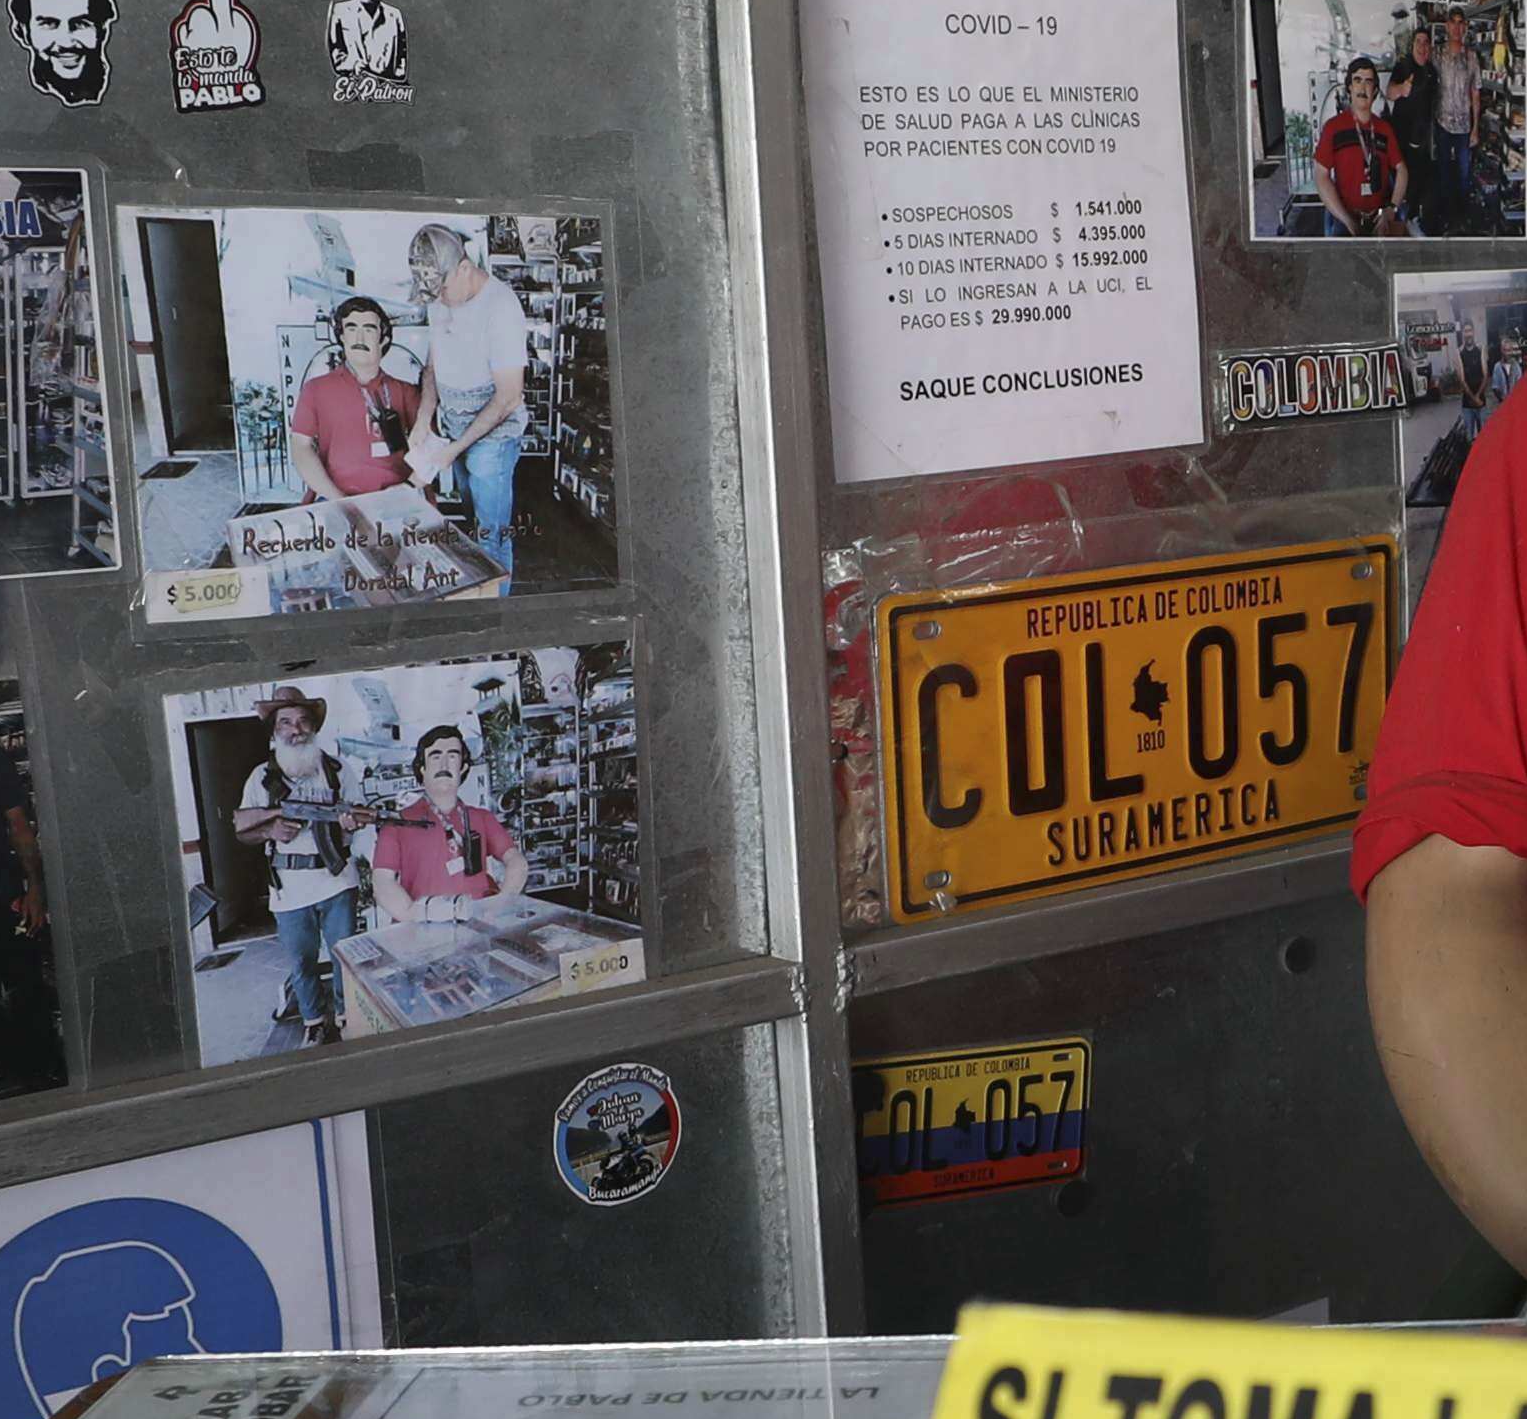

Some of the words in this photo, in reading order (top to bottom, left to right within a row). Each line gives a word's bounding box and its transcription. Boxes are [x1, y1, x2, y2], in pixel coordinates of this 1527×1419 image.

[945, 13, 1011, 35] COVID
[1036, 16, 1057, 36] 19
[179, 83, 262, 110] PABLO
[860, 86, 907, 103] ESTO
[917, 86, 939, 103] ES
[948, 87, 970, 103] LO
[979, 86, 1015, 103] QUE
[1023, 87, 1042, 103] EL
[1050, 86, 1138, 102] MINISTERIO
[892, 204, 1013, 223] SOSPECHOSOS
[1050, 202, 1059, 218] $
[1075, 199, 1142, 216] 1.541.000
[900, 376, 976, 401] SAQUE
[982, 362, 1143, 395] CONCLUSIONES
[1228, 349, 1408, 423] COLOMBIA
[166, 584, 179, 606] $
[184, 582, 237, 603] 5.000
[1026, 592, 1149, 640] REPUBLICA
[1153, 588, 1179, 619] DE
[1185, 575, 1283, 612] COLOMBIA
[917, 639, 1144, 831] COL
[1185, 601, 1378, 780] 057
[1136, 728, 1166, 754] 1810
[1045, 778, 1281, 868] SURAMERICA
[982, 1067, 1077, 1164] 057
